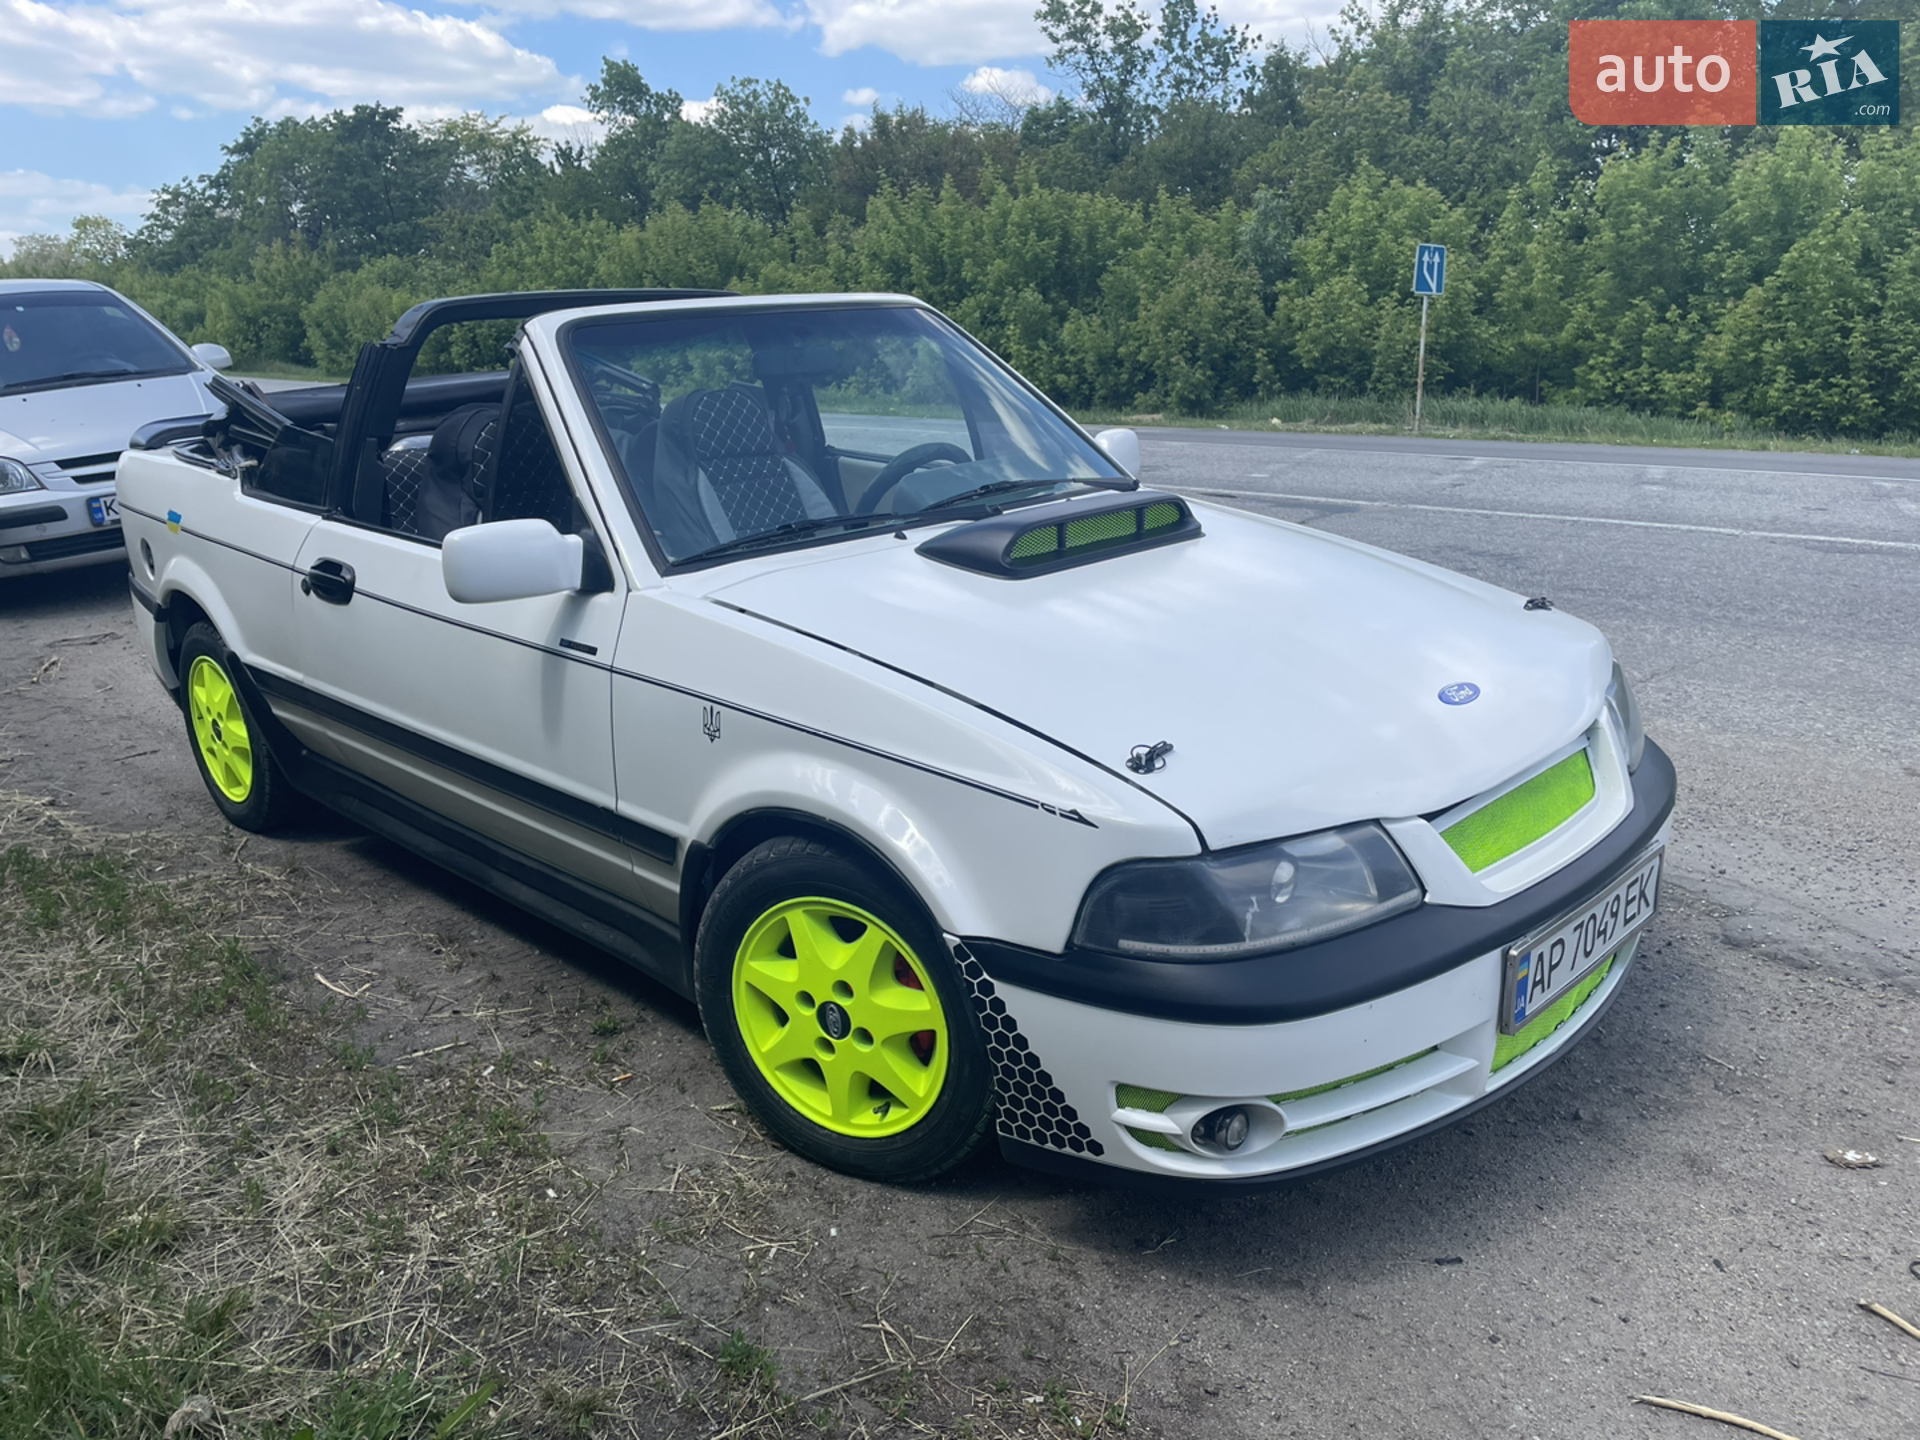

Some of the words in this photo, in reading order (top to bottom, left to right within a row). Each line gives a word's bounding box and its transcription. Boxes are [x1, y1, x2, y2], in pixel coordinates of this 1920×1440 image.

[104, 498, 120, 516] K
[1444, 682, 1473, 702] Ford
[1528, 937, 1565, 1004] AP
[1570, 893, 1621, 972] 7049
[1623, 864, 1655, 928] EK
